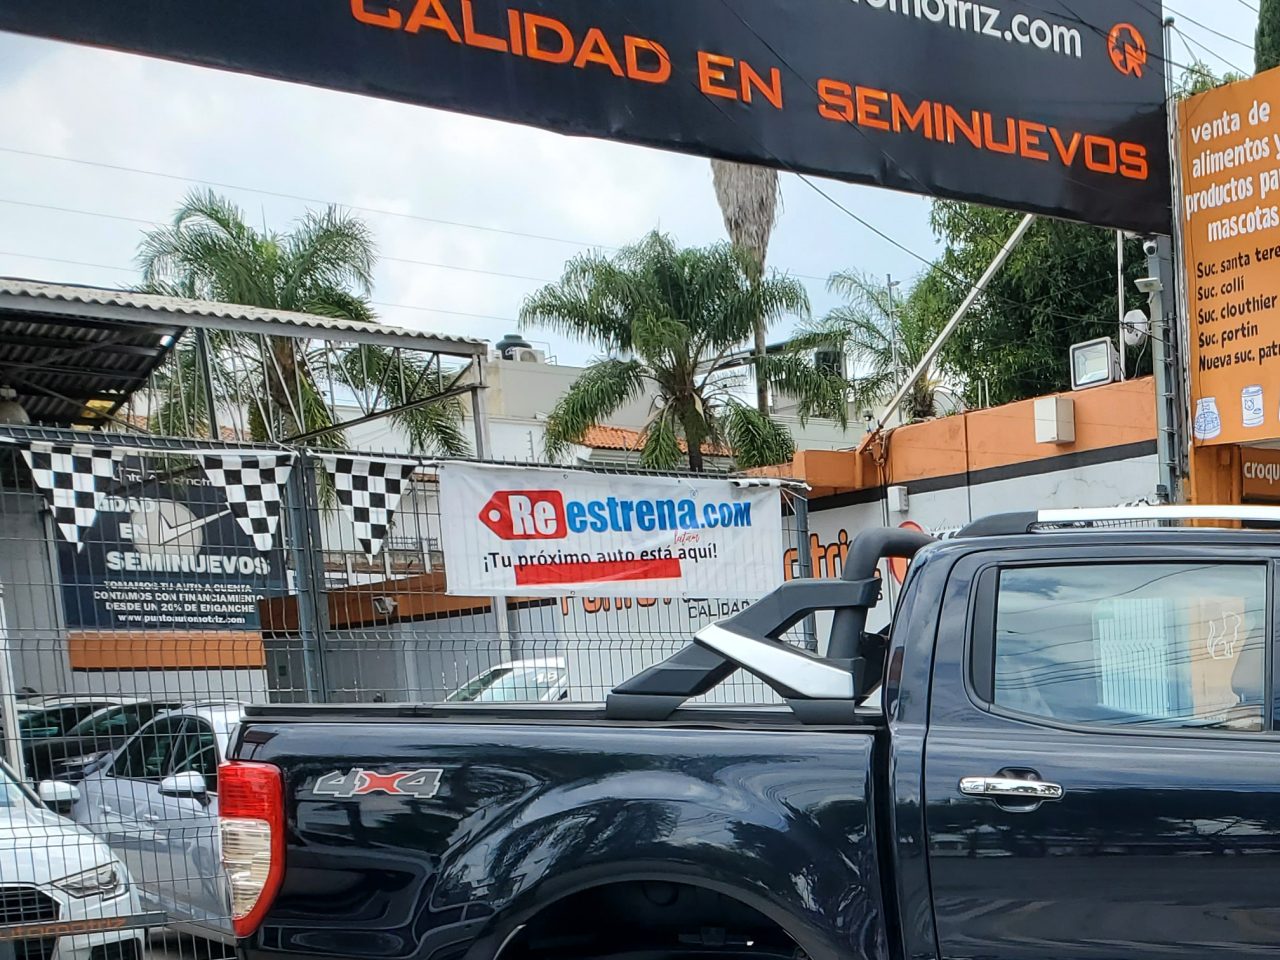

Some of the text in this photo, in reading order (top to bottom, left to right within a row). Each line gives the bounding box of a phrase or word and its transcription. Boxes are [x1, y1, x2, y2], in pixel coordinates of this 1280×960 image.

[697, 51, 783, 110] EN
[816, 78, 1149, 181] SEMINUEVOS
[1191, 99, 1271, 144] venta de
[1192, 136, 1270, 179] alimentos
[1185, 176, 1253, 221] productos
[1208, 205, 1280, 243] mascotas
[1197, 261, 1219, 279] Suc.
[1220, 252, 1251, 273] santa
[1197, 286, 1218, 302] Suc.
[1198, 294, 1278, 325] Suc. clouthier
[1198, 332, 1219, 349] Suc.
[1199, 353, 1232, 373] Nueva
[1234, 348, 1256, 365] suc.
[119, 523, 148, 540] EN
[105, 550, 272, 575] SEMINUEVOS
[483, 543, 718, 573] ¡Tu próximo auto está aquí!
[94, 590, 265, 603] CONTAMOS CON FINANCIAMIENTO
[105, 602, 256, 613] DESDE UN 20% DE ENGANCHE
